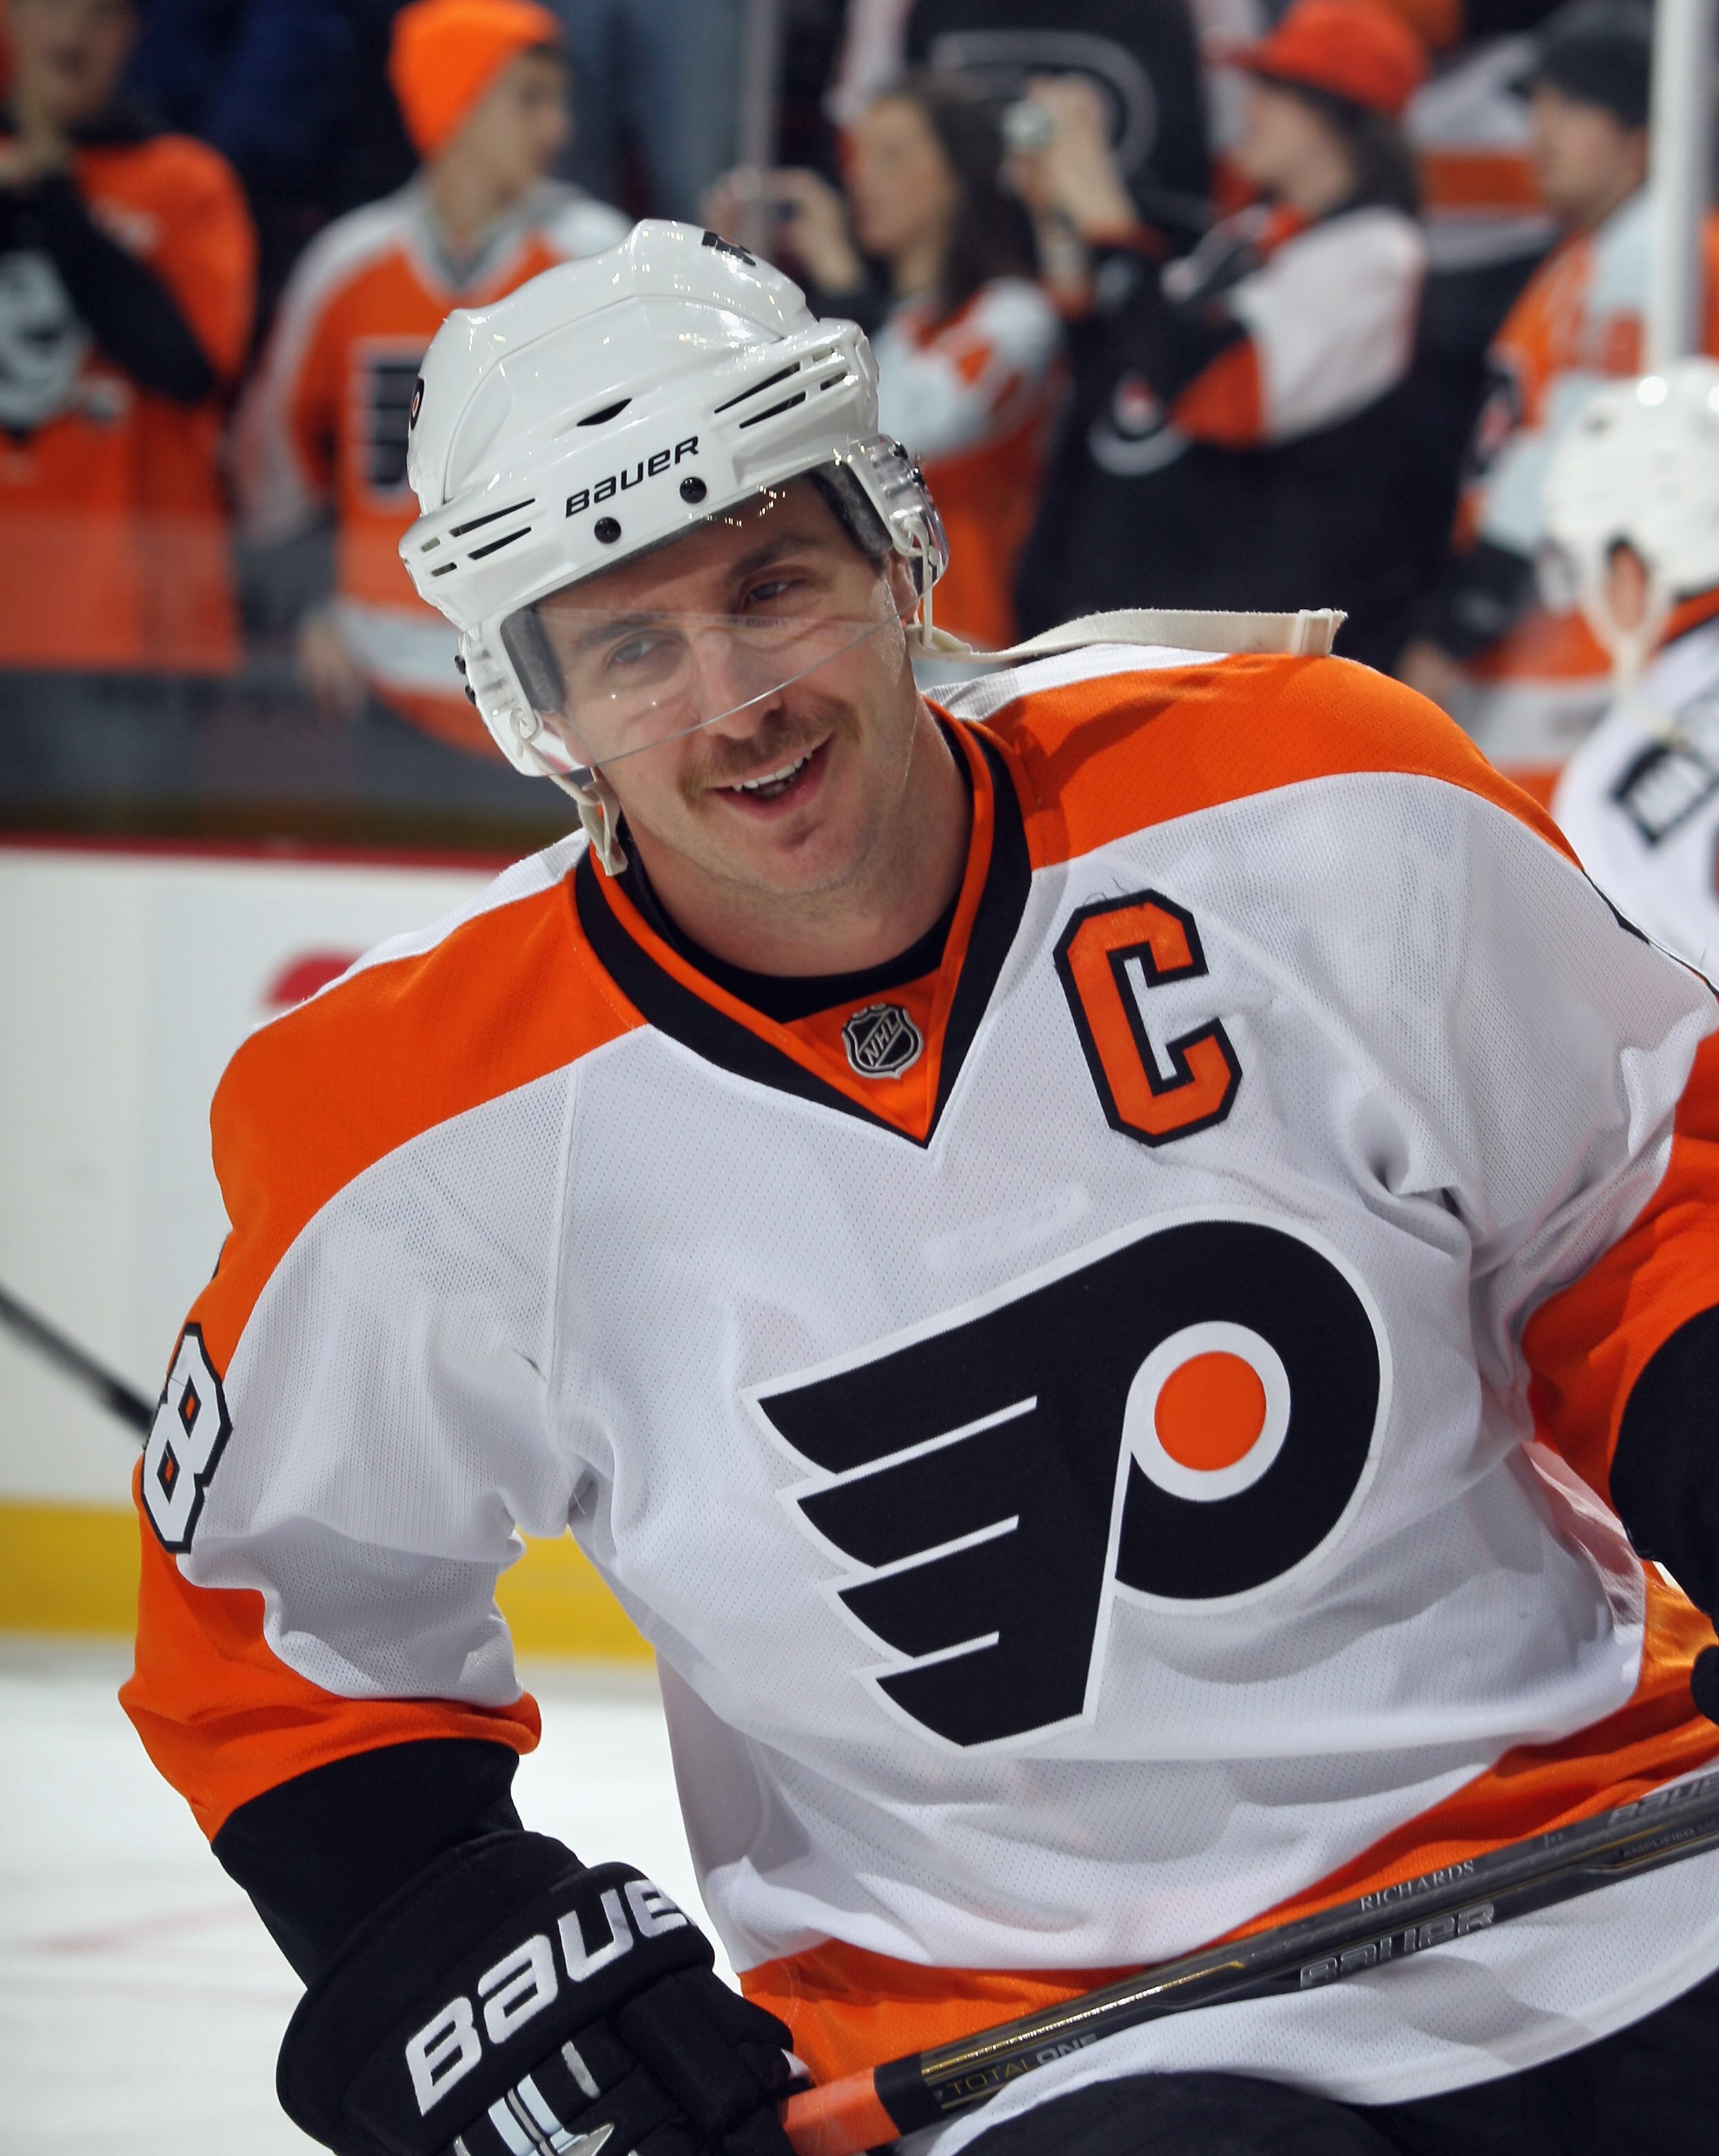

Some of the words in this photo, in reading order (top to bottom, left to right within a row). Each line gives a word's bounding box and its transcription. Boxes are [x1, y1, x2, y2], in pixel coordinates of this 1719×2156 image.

[864, 1017, 900, 1066] NHL
[1052, 888, 1244, 1148] C
[142, 1322, 234, 1553] 8
[1360, 1860, 1475, 1912] RICHARDS
